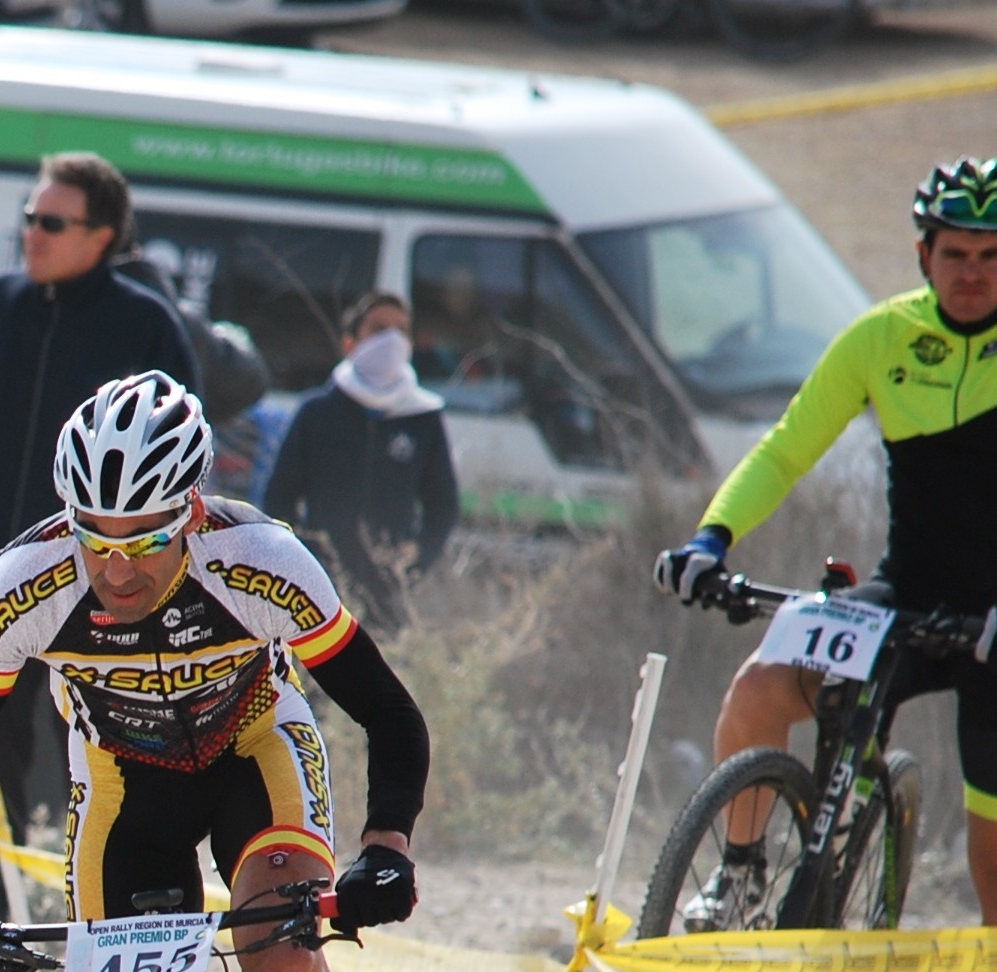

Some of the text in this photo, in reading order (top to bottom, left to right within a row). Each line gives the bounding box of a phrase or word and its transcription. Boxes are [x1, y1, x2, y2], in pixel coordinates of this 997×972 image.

[805, 626, 857, 663] 16
[90, 926, 110, 936] OPEN
[110, 923, 133, 933] RALLY
[164, 919, 175, 929] DE
[176, 918, 204, 928] MURCIA
[97, 929, 189, 948] GRAN PREMIO BP
